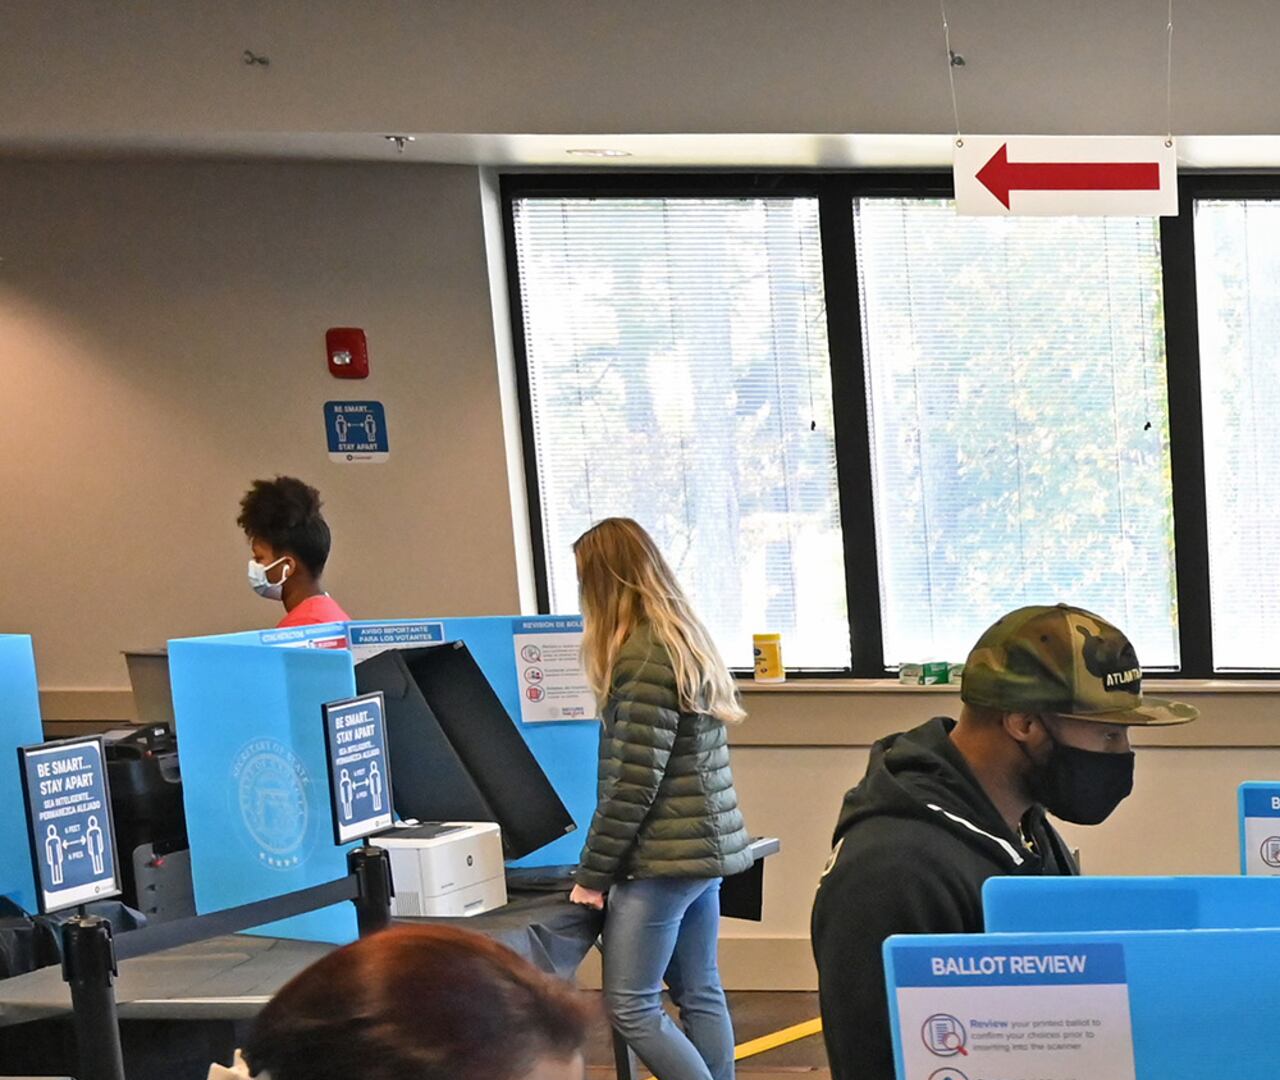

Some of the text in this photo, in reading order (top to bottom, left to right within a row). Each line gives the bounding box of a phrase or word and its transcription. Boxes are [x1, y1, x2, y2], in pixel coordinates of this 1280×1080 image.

[380, 634, 394, 642] LOS
[395, 633, 432, 641] VOTANTES
[335, 717, 344, 729] BE
[336, 724, 375, 744] STAY APART
[37, 763, 50, 778] BE
[40, 773, 93, 796] STAY APART
[44, 799, 55, 809] SEA
[76, 801, 101, 813] ALEJADO
[931, 955, 1087, 976] BALLOT REVIEW
[970, 1019, 1009, 1028] Review
